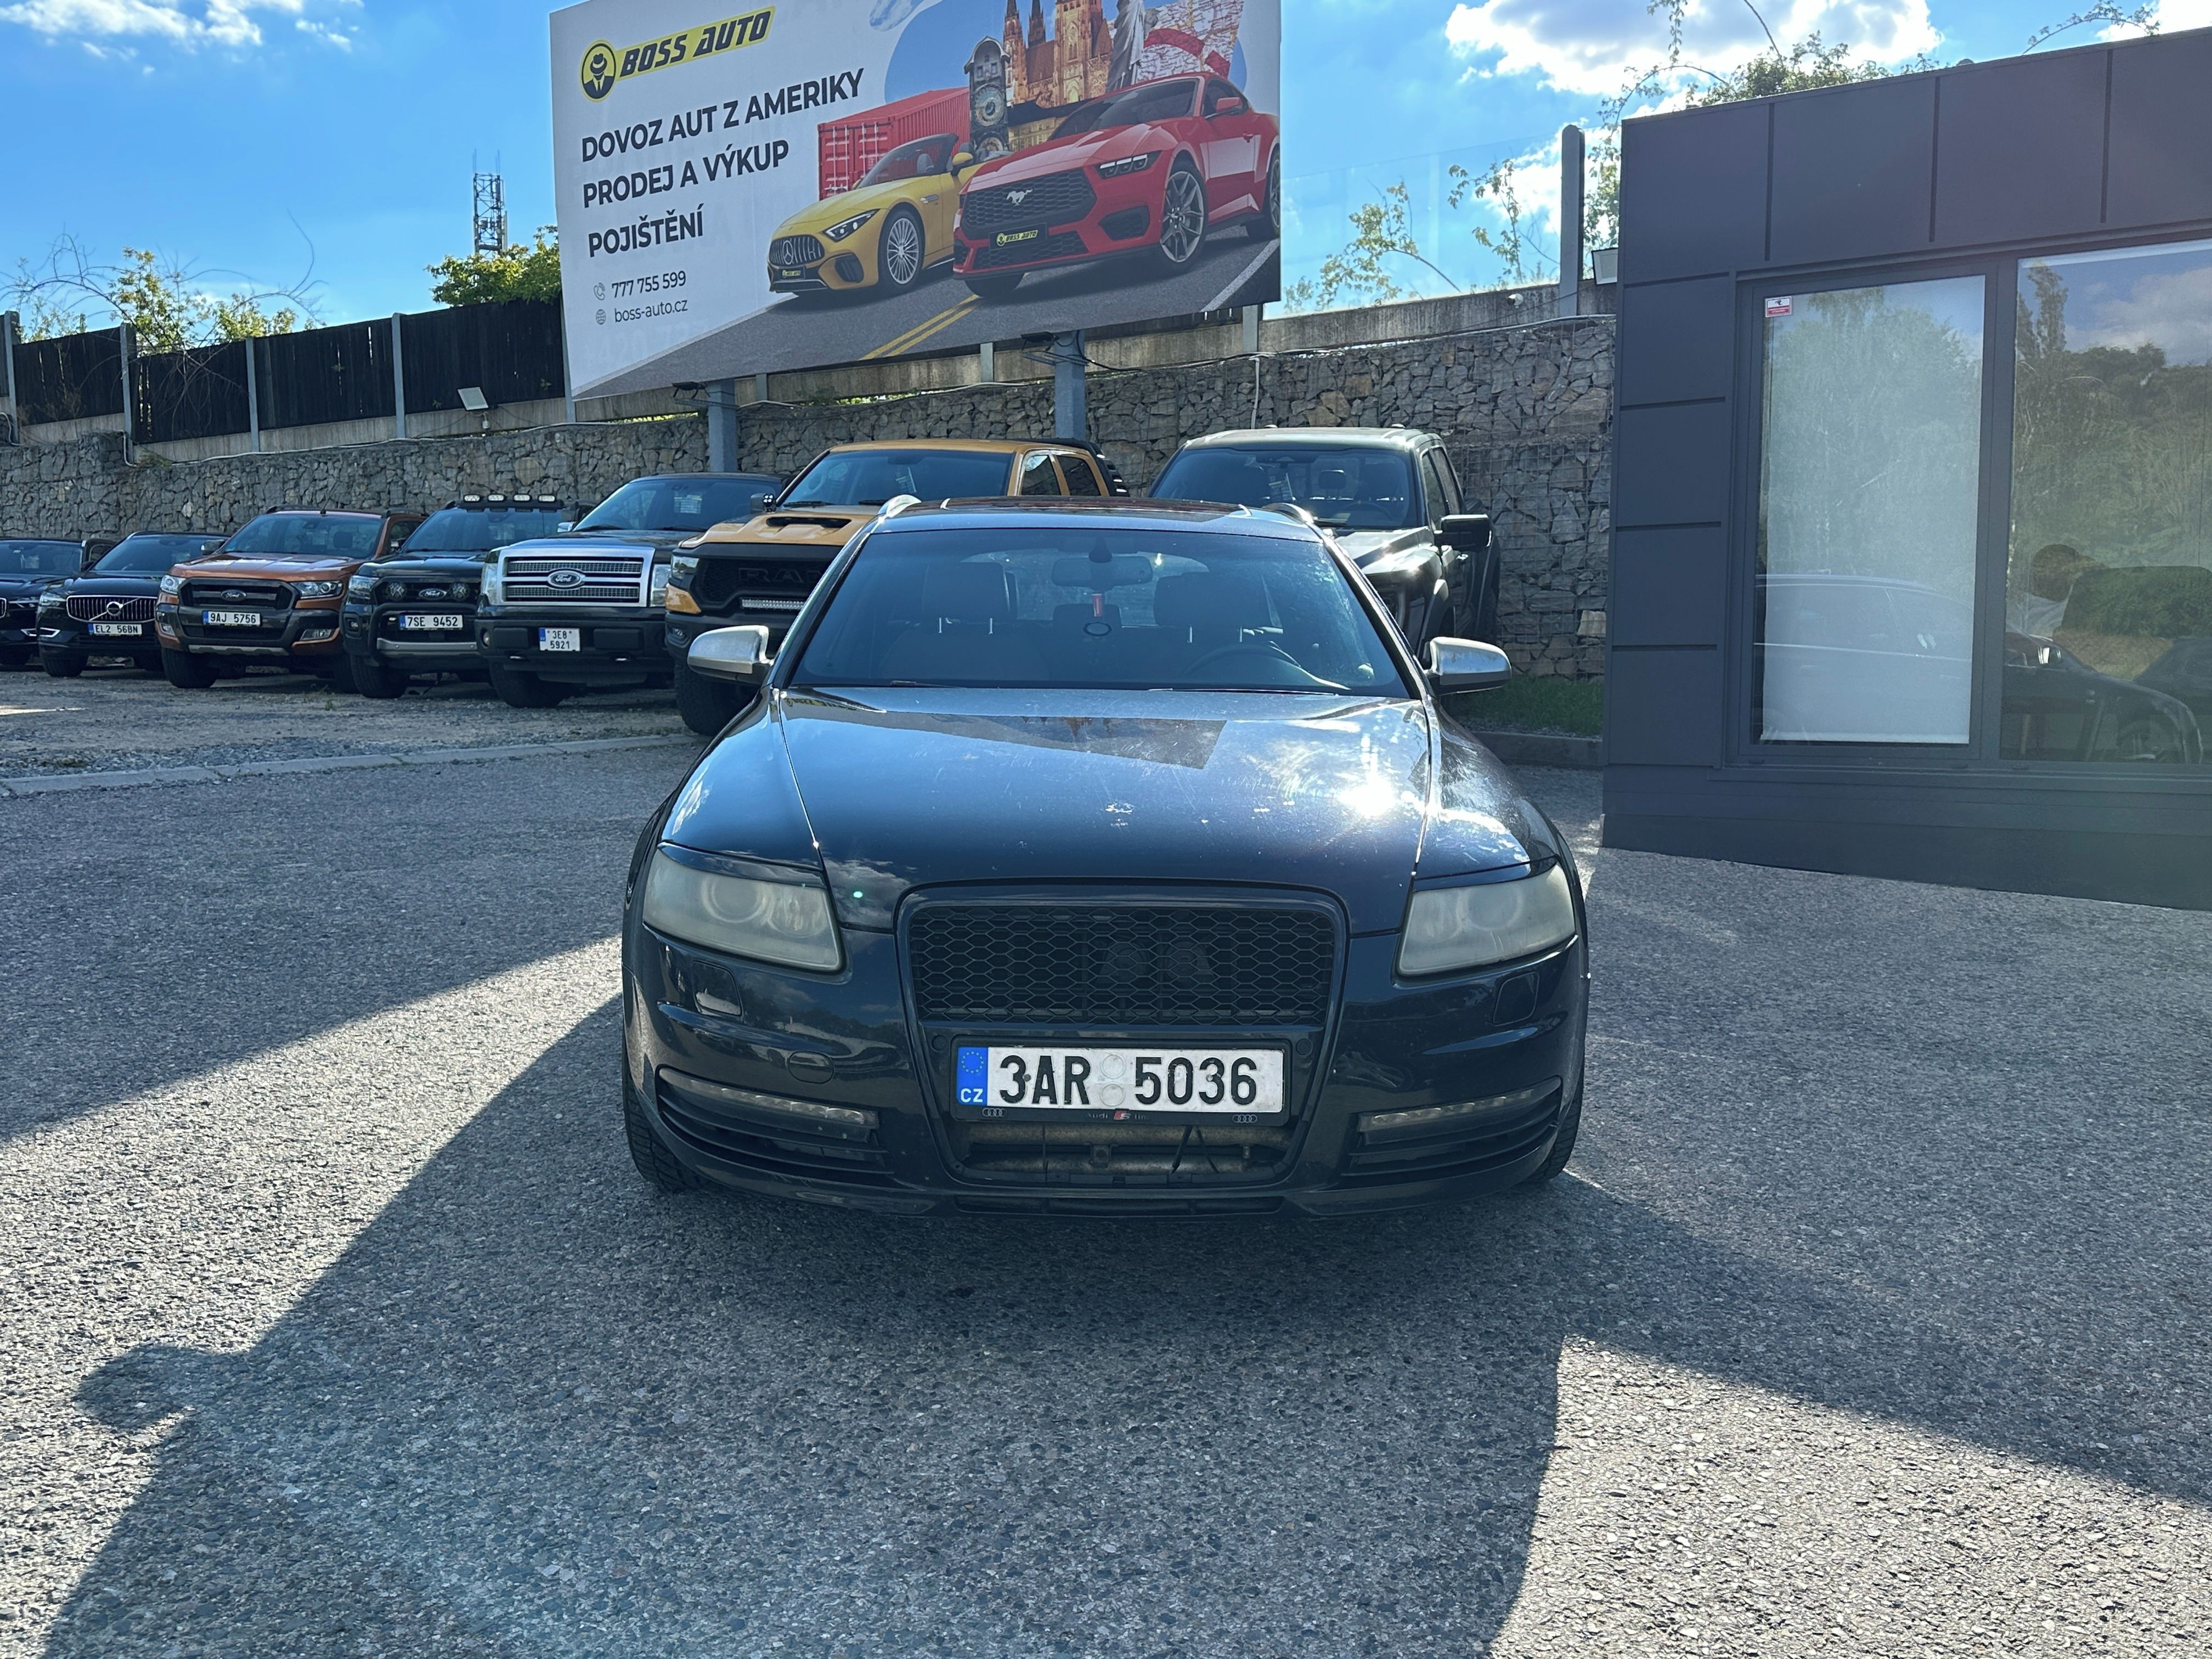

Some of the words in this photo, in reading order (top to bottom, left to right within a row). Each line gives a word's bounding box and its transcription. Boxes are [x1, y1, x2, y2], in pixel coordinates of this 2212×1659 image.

[620, 34, 688, 77] BOSS
[693, 11, 771, 57] AUTO
[582, 119, 663, 162] DOVOZ
[668, 106, 717, 142] AUT
[723, 100, 739, 128] Z
[745, 68, 864, 124] AMERIKY
[584, 165, 674, 208] PRODEJ
[680, 161, 698, 187] A
[703, 139, 789, 182] VÝKUP
[589, 204, 704, 257] POJIŠTĚNÍ
[612, 280, 634, 298] 777
[637, 275, 659, 294] 755
[663, 270, 686, 289] 599
[614, 300, 688, 323] boss-auto.cz
[95, 625, 111, 633] EL2
[211, 613, 227, 622] 9AJ
[234, 614, 256, 623] 5756
[408, 617, 425, 627] 7SE
[433, 617, 458, 627] 9452
[550, 641, 570, 649] 5921
[552, 630, 567, 639] 3E8
[1000, 1055, 1091, 1105] 3AR
[1135, 1057, 1257, 1105] 5036
[961, 1088, 983, 1103] CZ
